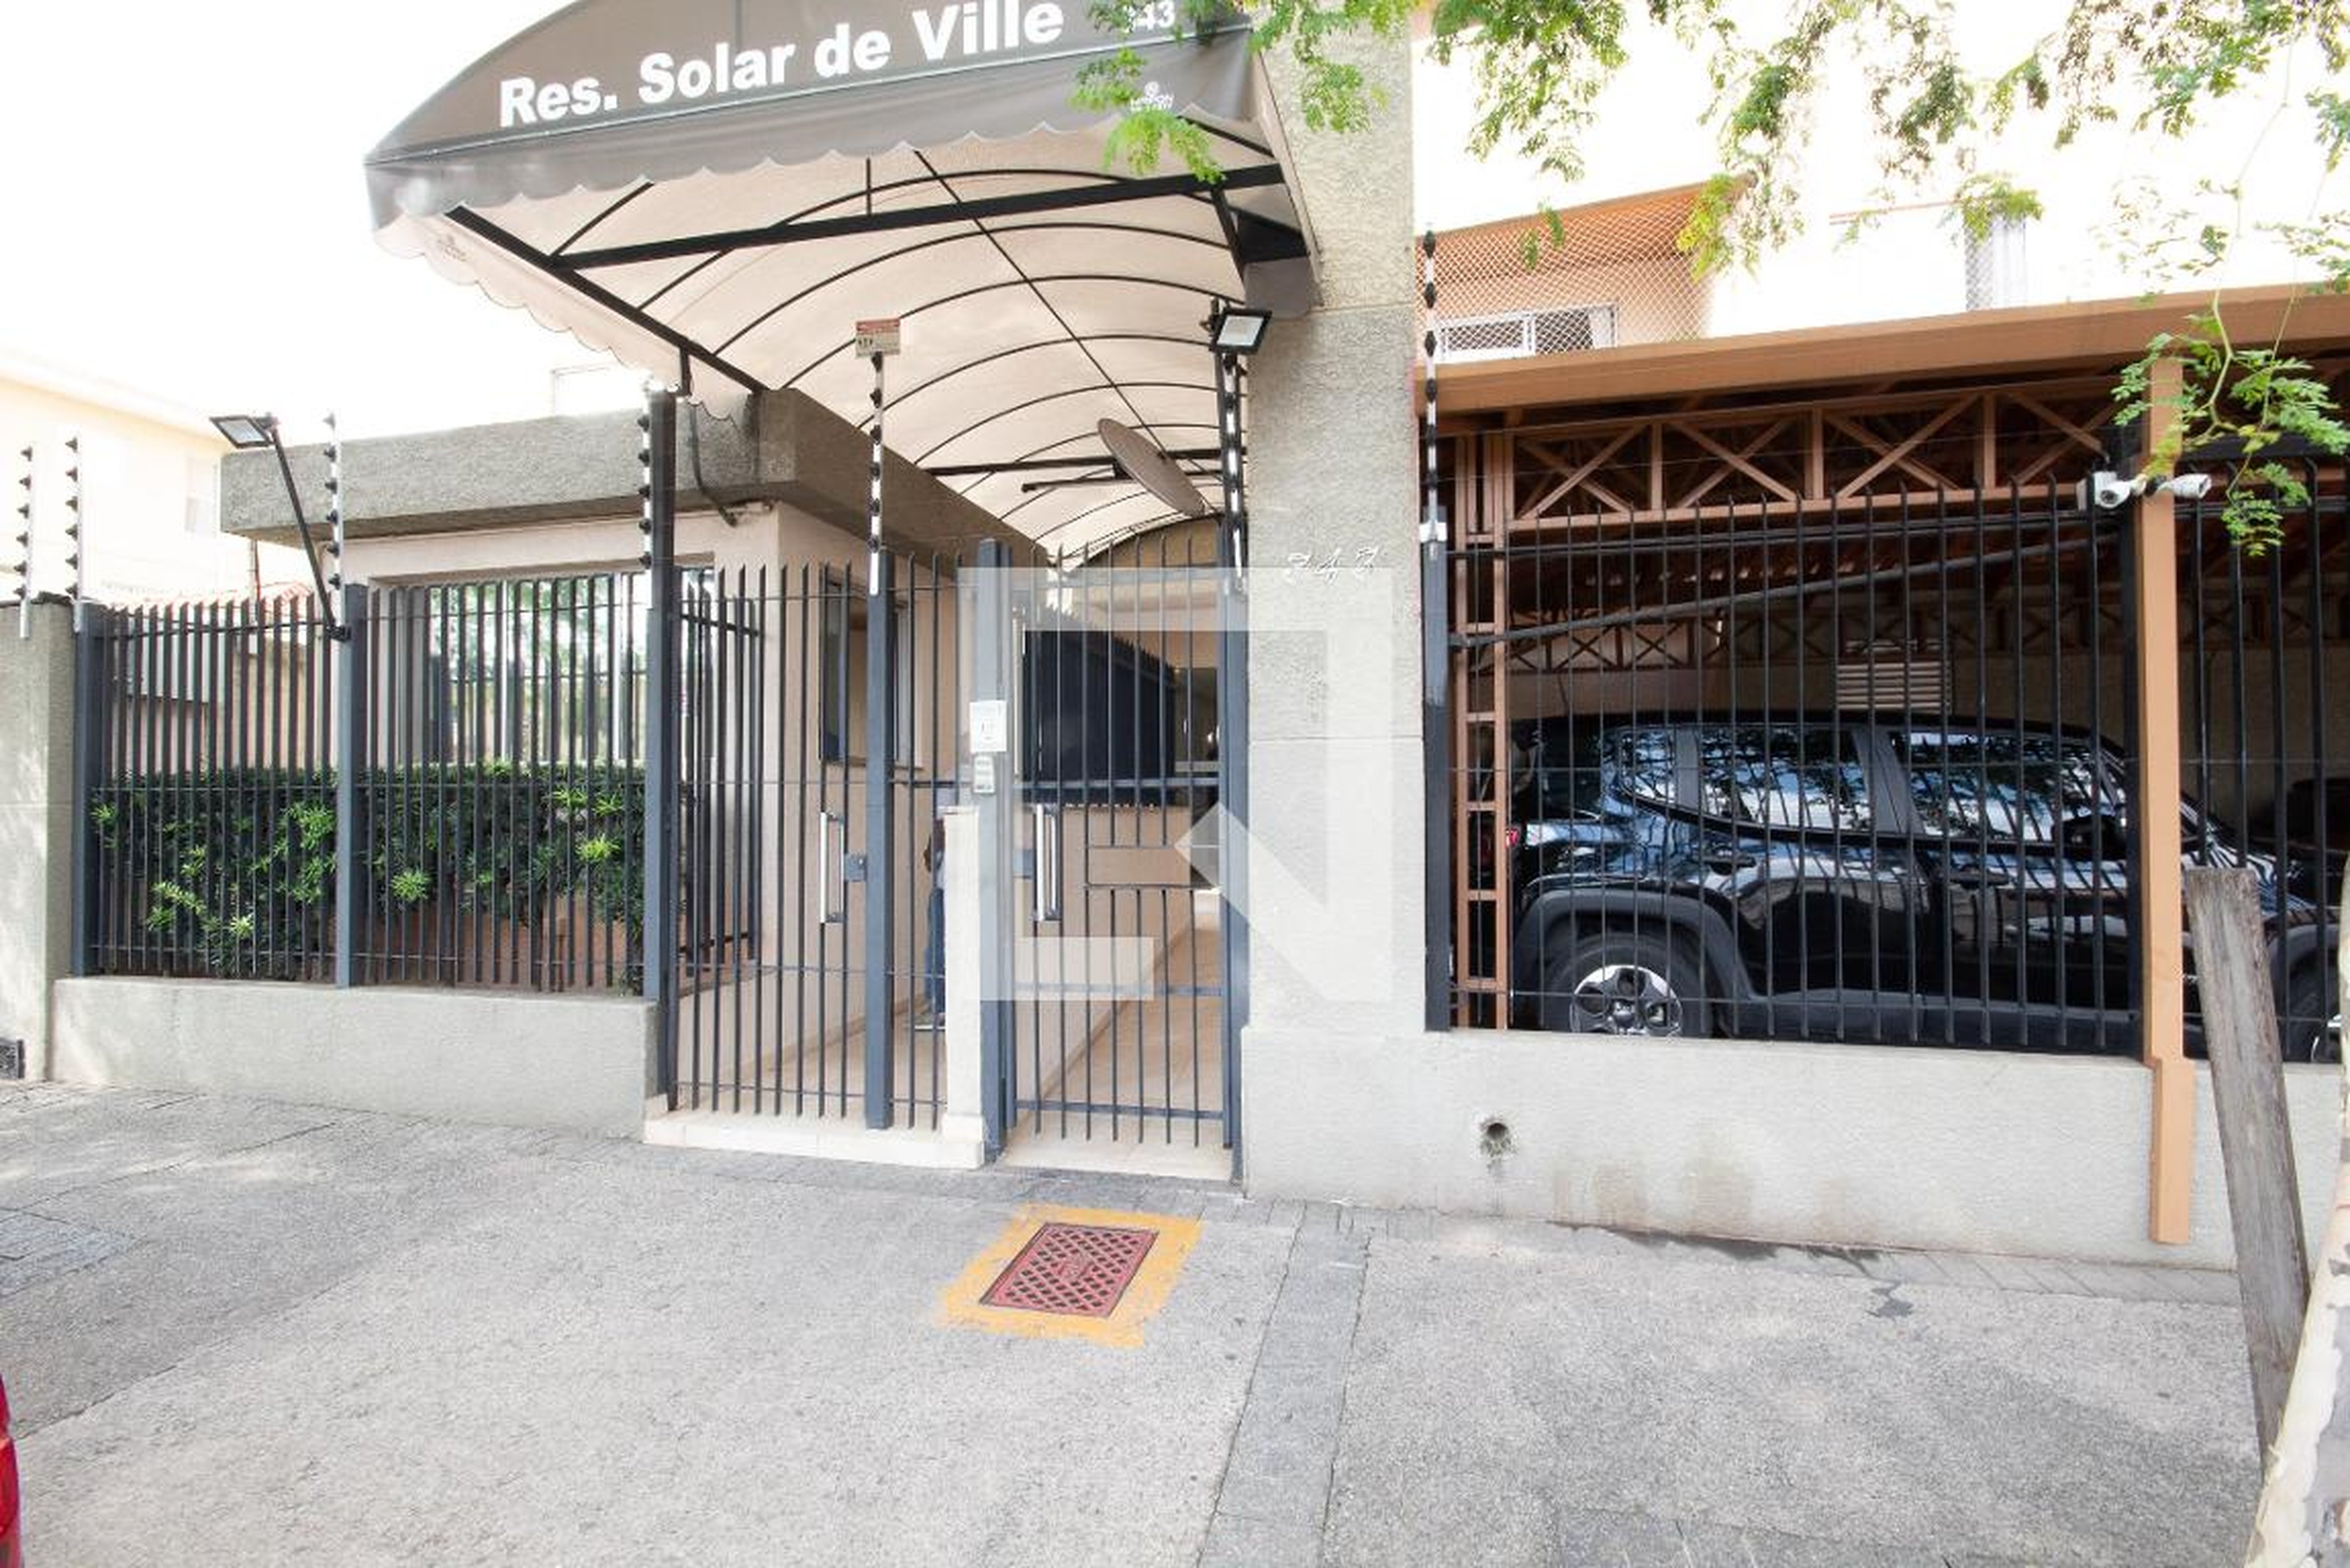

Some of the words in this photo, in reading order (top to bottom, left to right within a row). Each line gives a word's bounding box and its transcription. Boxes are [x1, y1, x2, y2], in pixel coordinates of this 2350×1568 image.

[499, 76, 618, 127] Res.
[638, 42, 796, 104] Solar
[815, 23, 892, 77] de
[912, 0, 1064, 61] Ville
